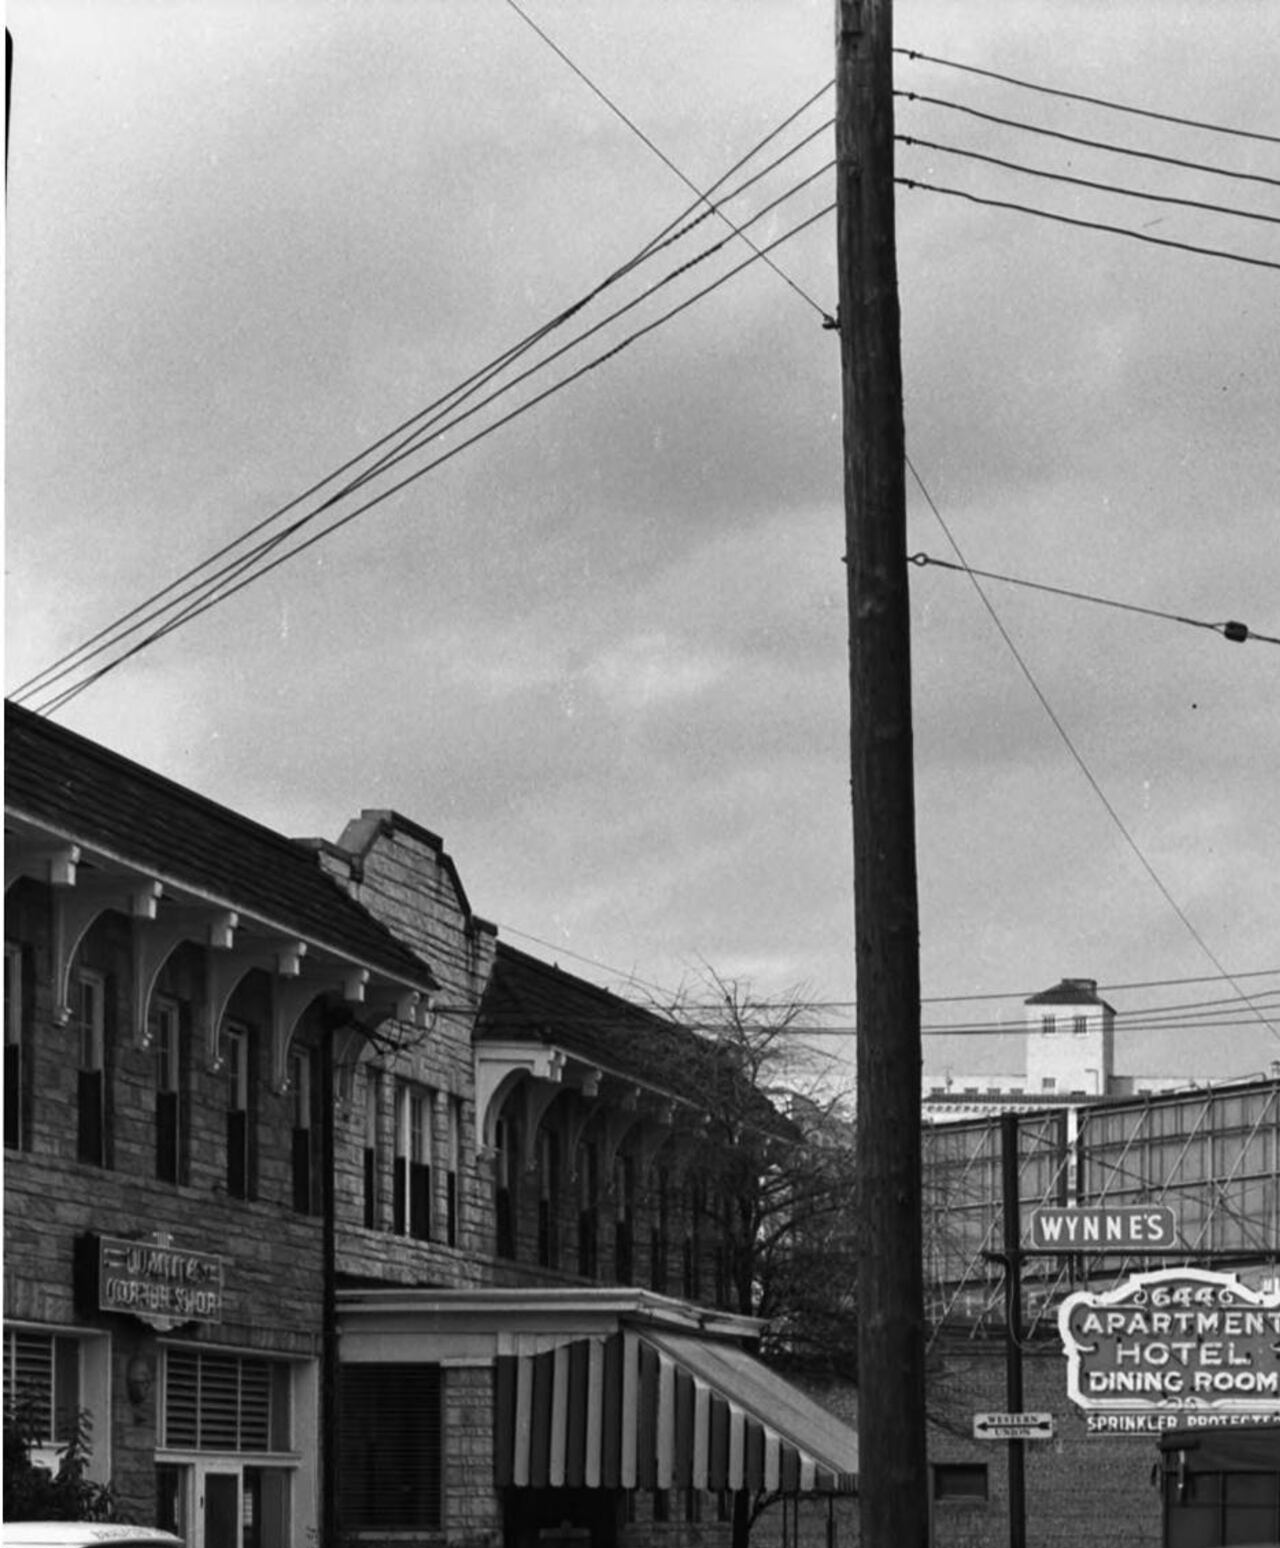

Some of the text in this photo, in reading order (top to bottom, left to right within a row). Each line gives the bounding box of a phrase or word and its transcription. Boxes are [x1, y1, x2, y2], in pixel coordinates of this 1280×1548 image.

[1040, 1214, 1164, 1241] WYNNE'S
[1152, 1287, 1216, 1306] 644
[1116, 1341, 1251, 1365] HOTEL
[1090, 1371, 1279, 1392] DINING ROOM
[1087, 1415, 1178, 1431] SPRINKLER
